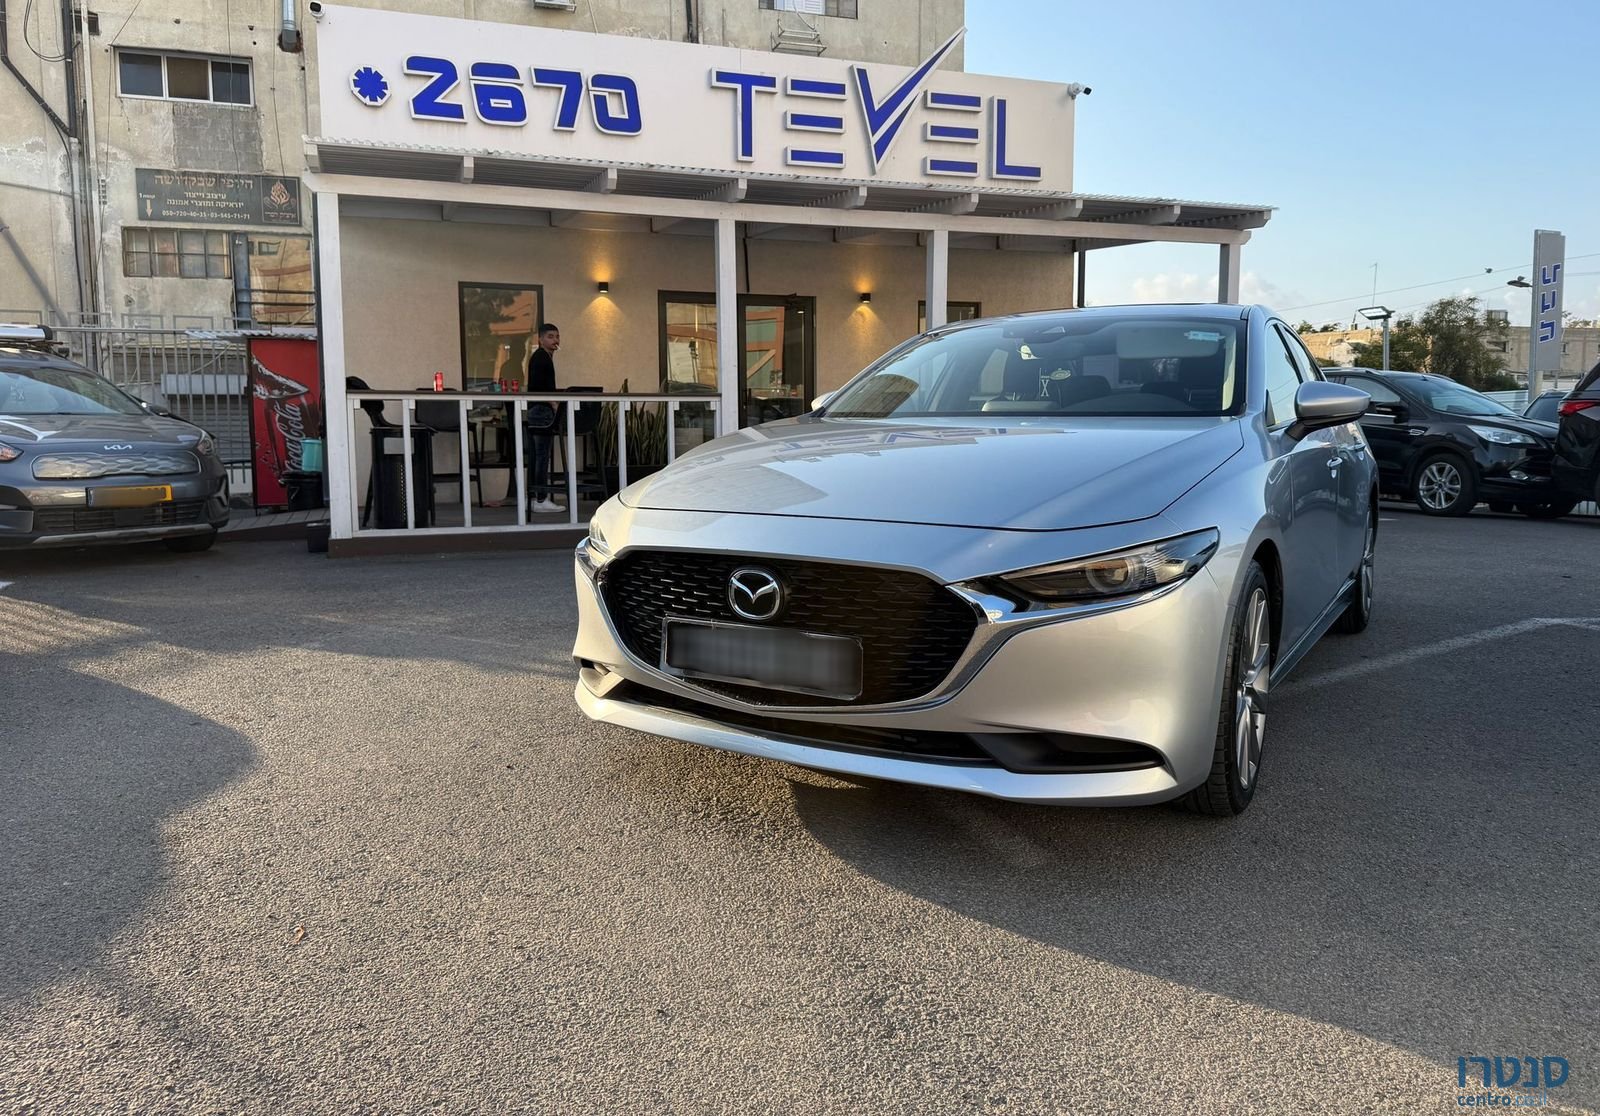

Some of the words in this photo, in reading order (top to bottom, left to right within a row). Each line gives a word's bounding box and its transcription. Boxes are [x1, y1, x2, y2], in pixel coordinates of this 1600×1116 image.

[710, 27, 1042, 180] TEVEL
[221, 178, 253, 189] היופי
[166, 198, 189, 206] אמונה
